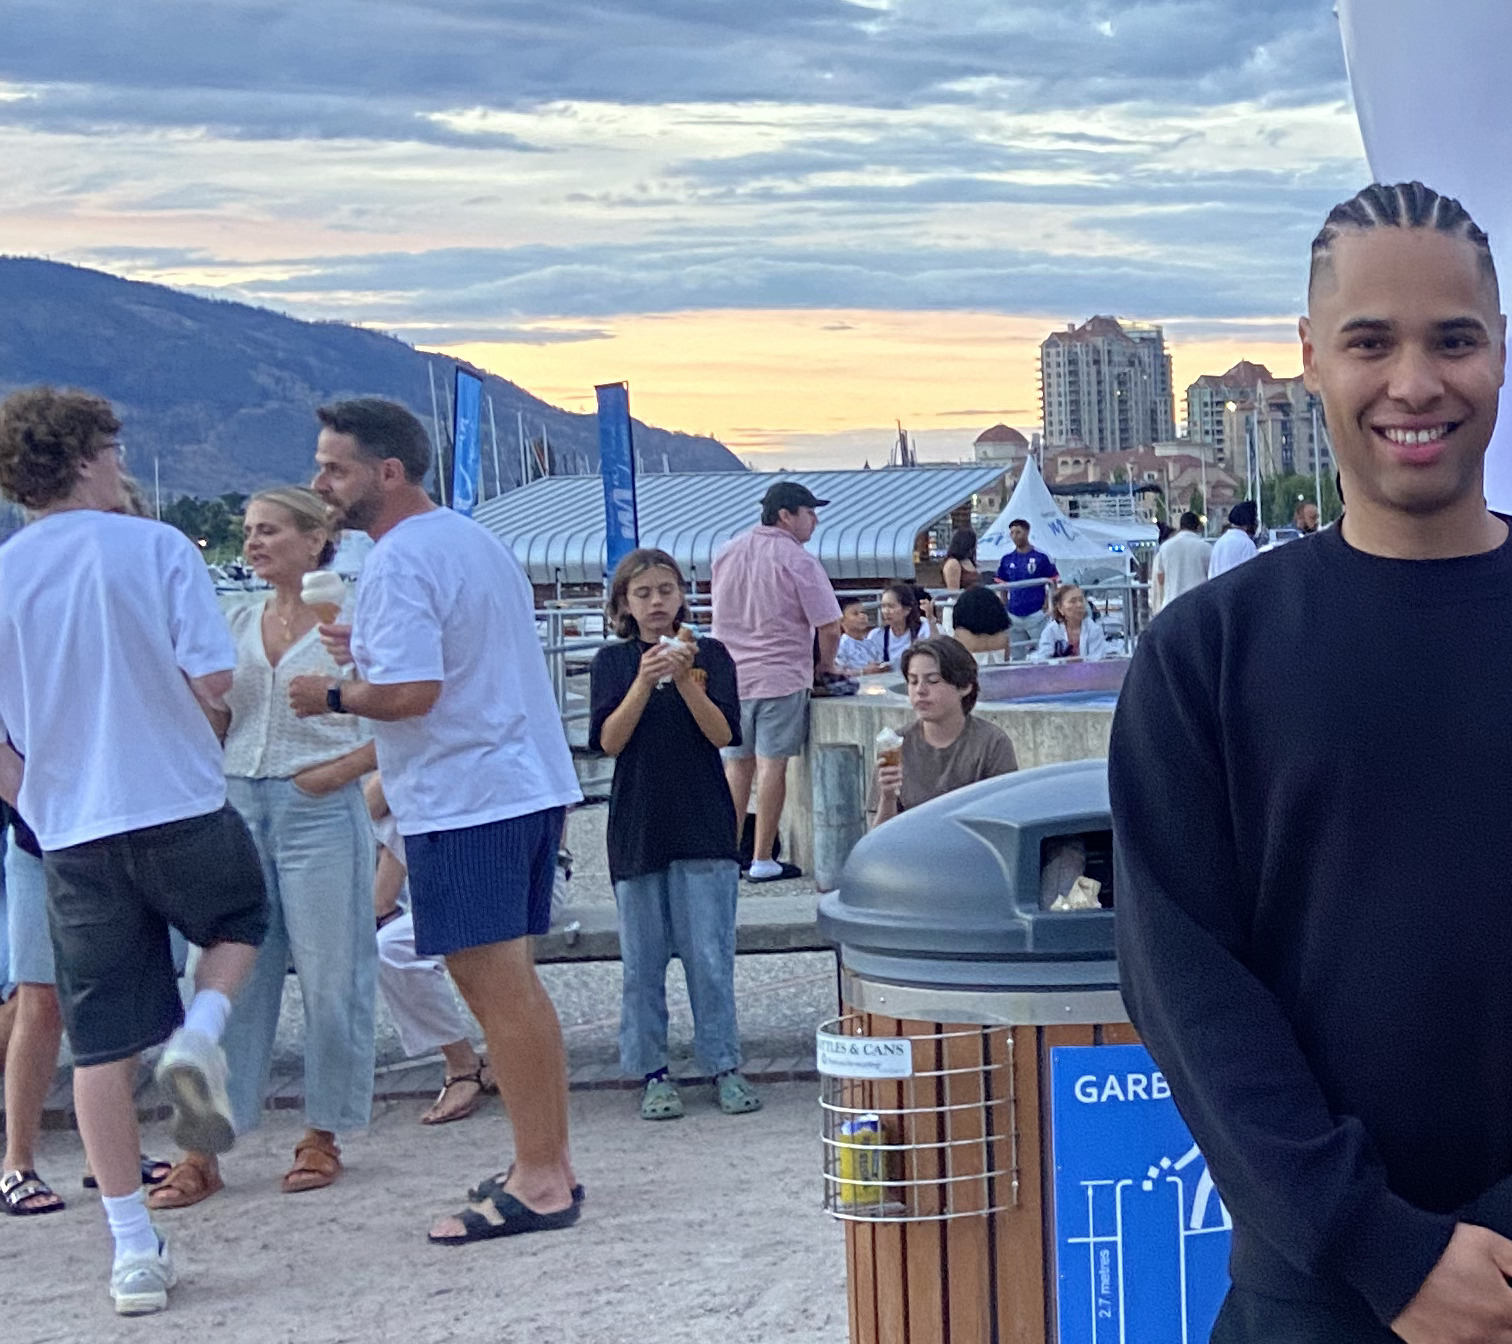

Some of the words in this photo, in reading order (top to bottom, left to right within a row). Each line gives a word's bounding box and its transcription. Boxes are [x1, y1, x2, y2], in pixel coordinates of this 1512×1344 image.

[849, 1043, 860, 1055] &
[863, 1042, 904, 1056] CANS
[1074, 1072, 1171, 1103] GARB
[1099, 1249, 1111, 1294] metres
